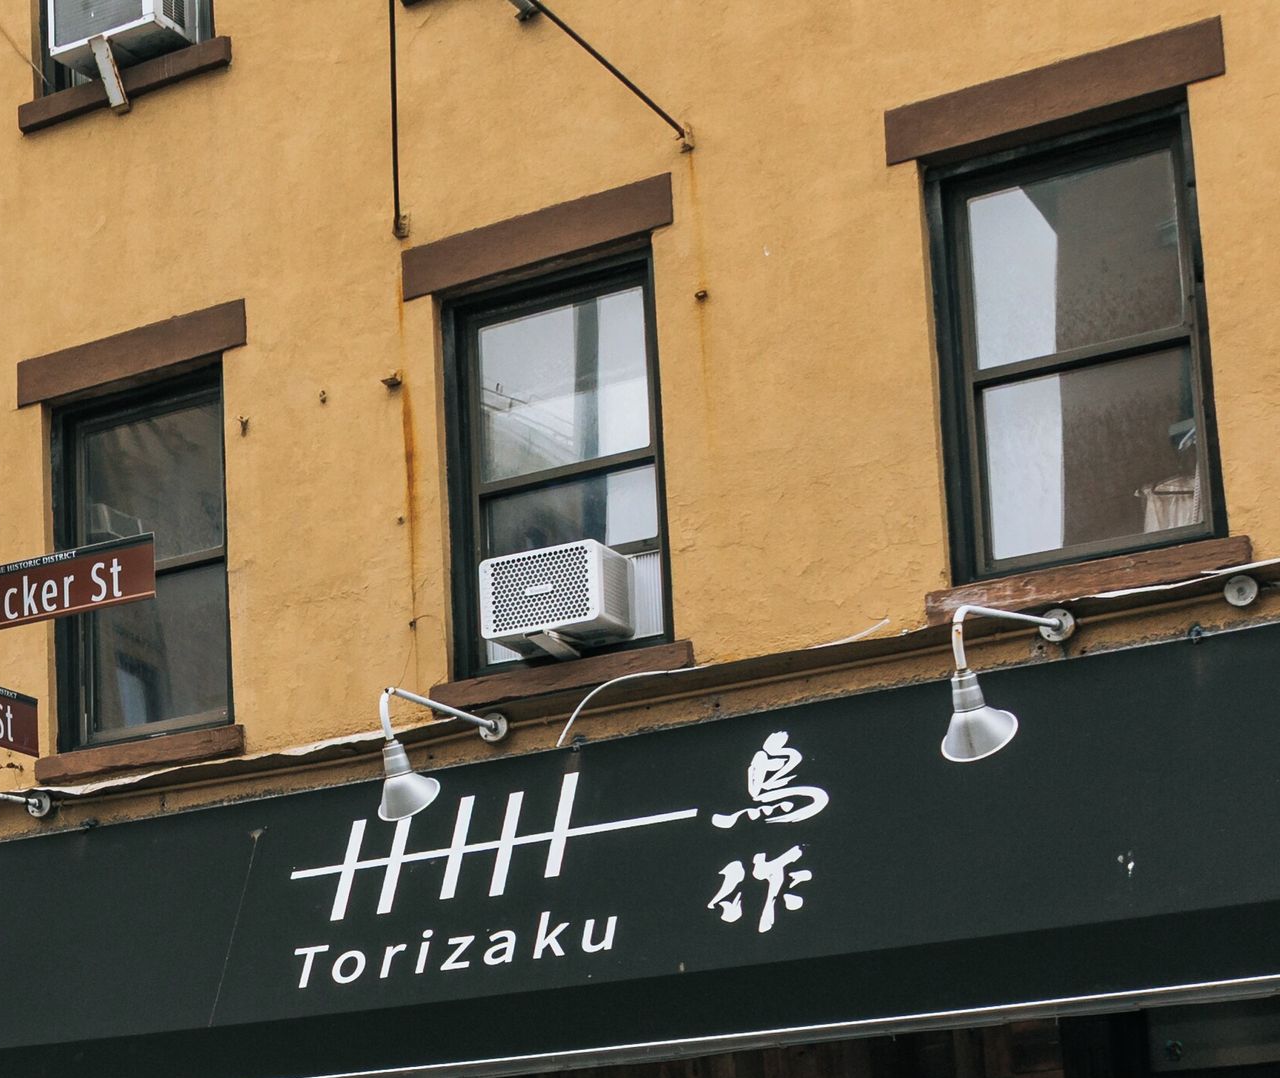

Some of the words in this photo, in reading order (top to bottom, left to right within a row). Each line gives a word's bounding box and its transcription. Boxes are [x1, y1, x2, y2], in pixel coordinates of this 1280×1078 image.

[7, 558, 40, 573] HISTORIC
[42, 550, 77, 565] DISTRICT
[90, 557, 123, 602] St
[293, 910, 618, 989] Torizaku
